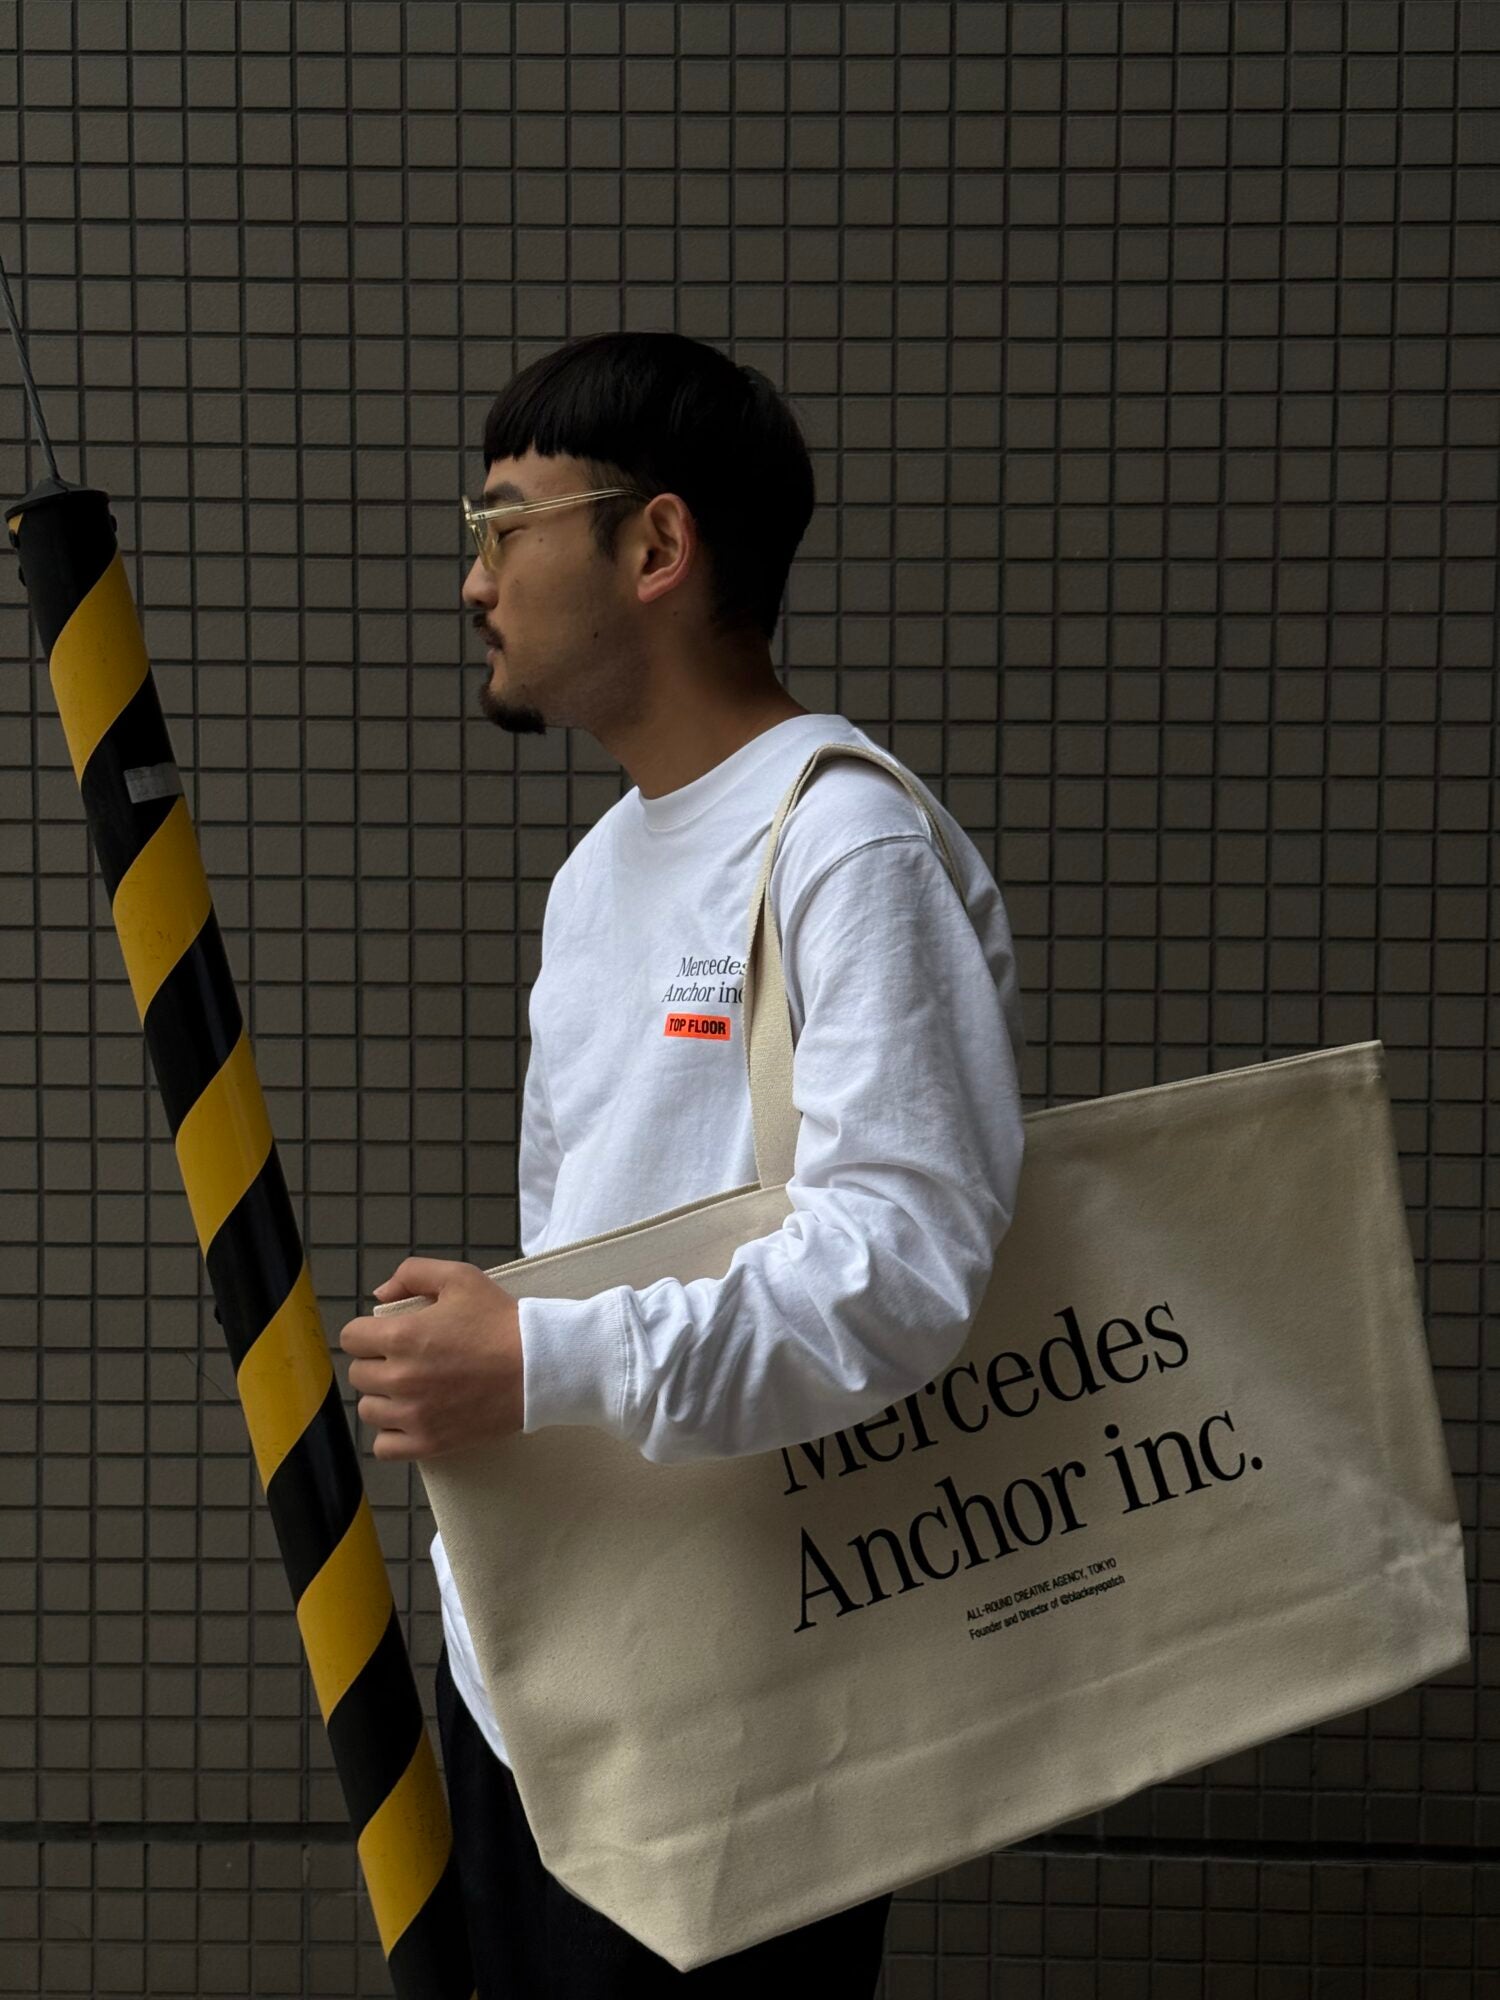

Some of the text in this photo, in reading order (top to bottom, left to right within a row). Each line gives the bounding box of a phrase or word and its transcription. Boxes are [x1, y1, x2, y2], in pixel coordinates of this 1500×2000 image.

[662, 982, 715, 1002] Anchor
[669, 1018, 726, 1035] TOP FLOOR
[793, 1410, 1263, 1633] Anchor inc.
[967, 1557, 1117, 1621] ALL-ROUND CREATIVE AGENCY, TOKYO
[969, 1575, 1126, 1640] Founder and Director of @blackeyepatch
